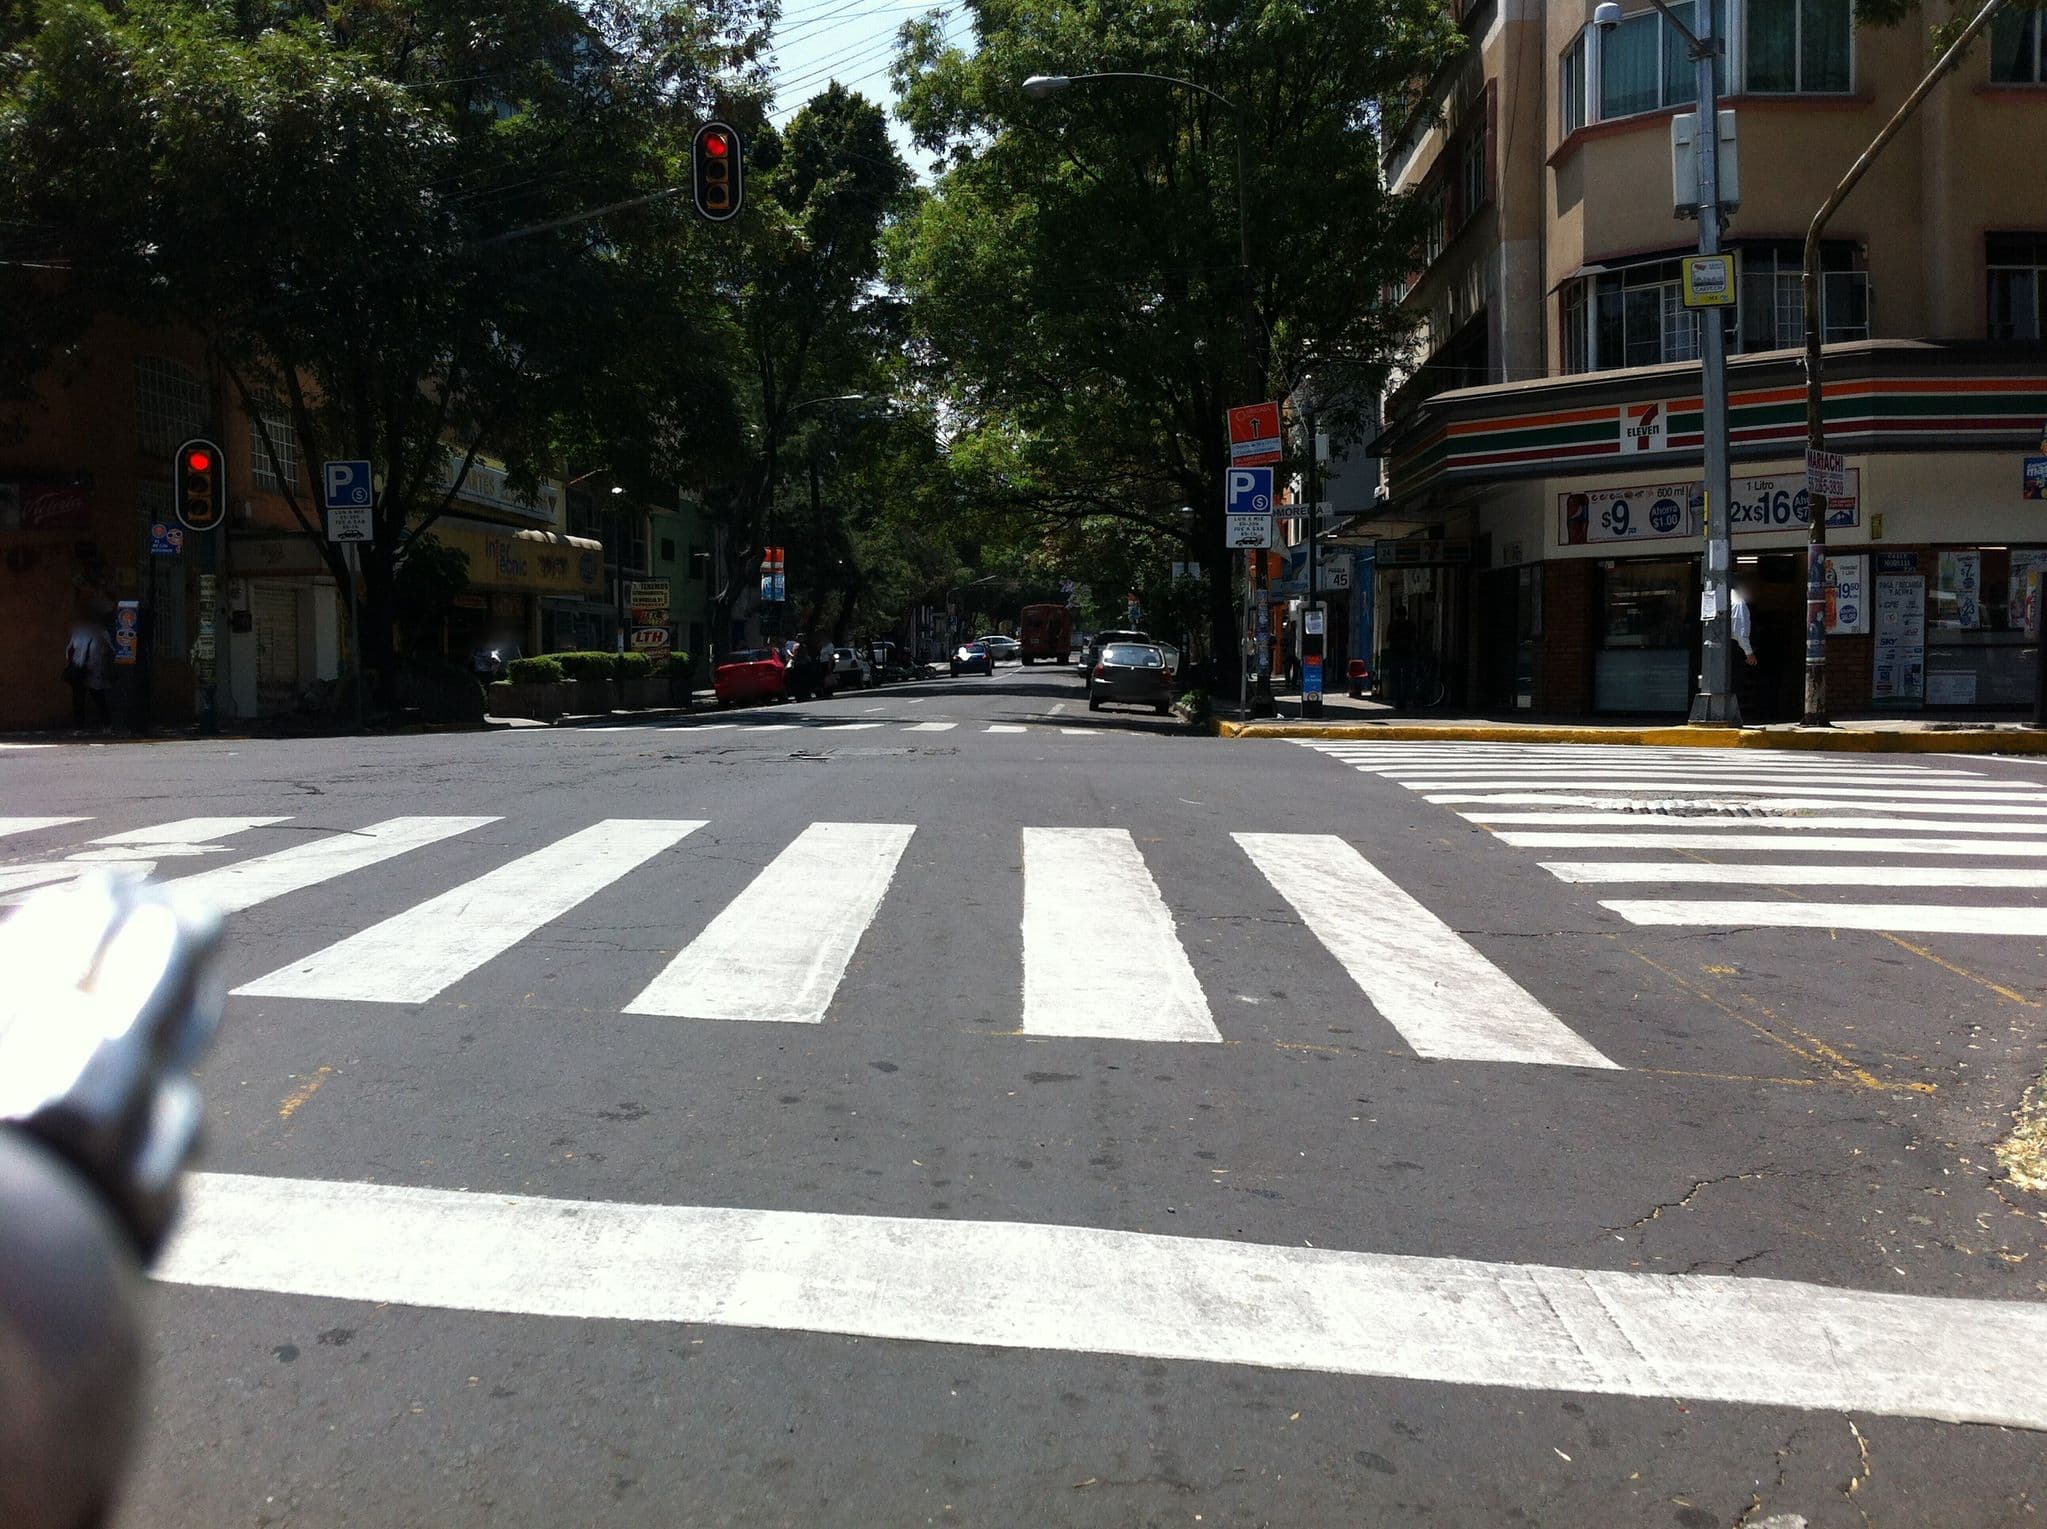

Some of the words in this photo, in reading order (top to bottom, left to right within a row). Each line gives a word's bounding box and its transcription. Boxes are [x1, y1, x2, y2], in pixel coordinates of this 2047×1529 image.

[1637, 403, 1658, 450] 7
[1808, 450, 1843, 472] MARIACHI
[328, 466, 353, 497] P
[1747, 482, 1751, 491] 1
[1754, 480, 1774, 490] Litro
[1230, 472, 1255, 504] P
[1657, 488, 1672, 497] 600
[1674, 487, 1685, 496] ml
[1652, 505, 1679, 516] Ahorra
[1653, 515, 1678, 527] $1.00
[1333, 574, 1348, 586] 45
[635, 631, 663, 642] LTH
[1880, 638, 1897, 646] SKY
